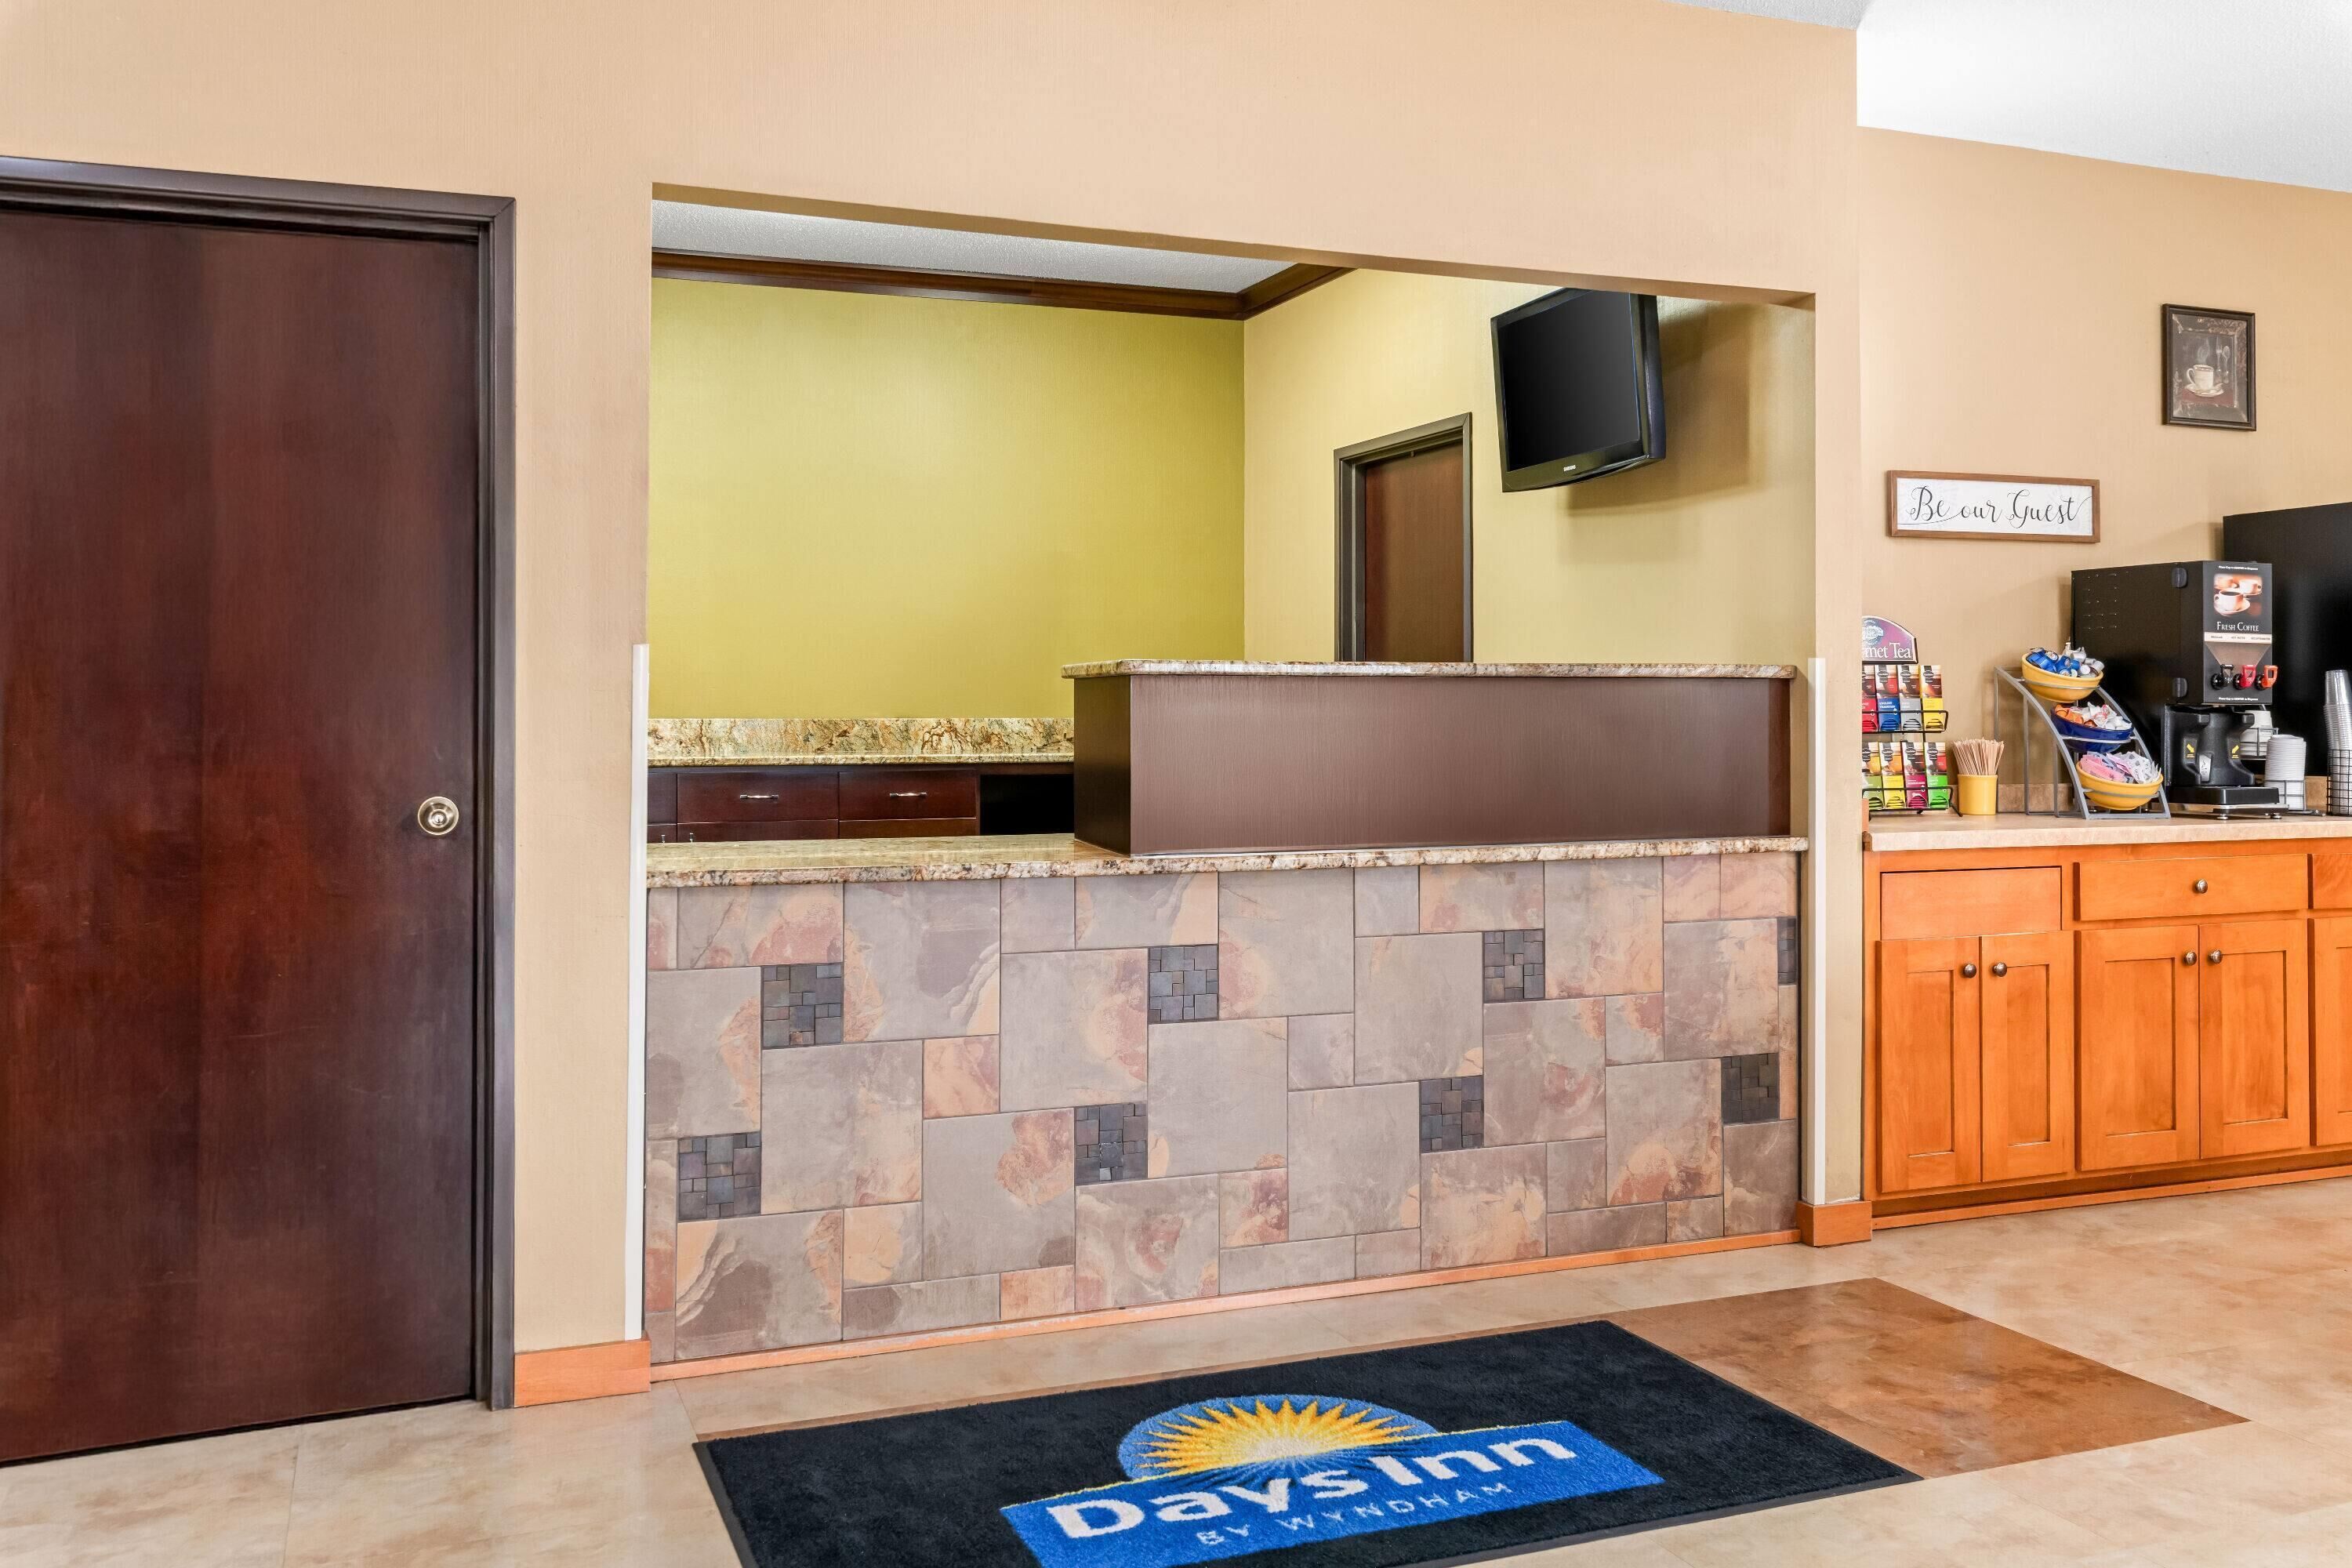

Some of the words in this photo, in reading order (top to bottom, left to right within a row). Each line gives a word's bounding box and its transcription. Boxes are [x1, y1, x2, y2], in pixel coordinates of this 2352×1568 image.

[1905, 485, 1951, 521] Be
[1959, 500, 2002, 523] our
[2006, 489, 2082, 528] Guest
[2216, 621, 2235, 630] FRESH
[2237, 622, 2259, 632] COFFEE
[1889, 642, 1911, 659] Tea
[1046, 1469, 1370, 1539] Days
[1369, 1438, 1577, 1486] Inn
[1196, 1523, 1251, 1545] BY
[1275, 1482, 1514, 1531] WYNDHAM
